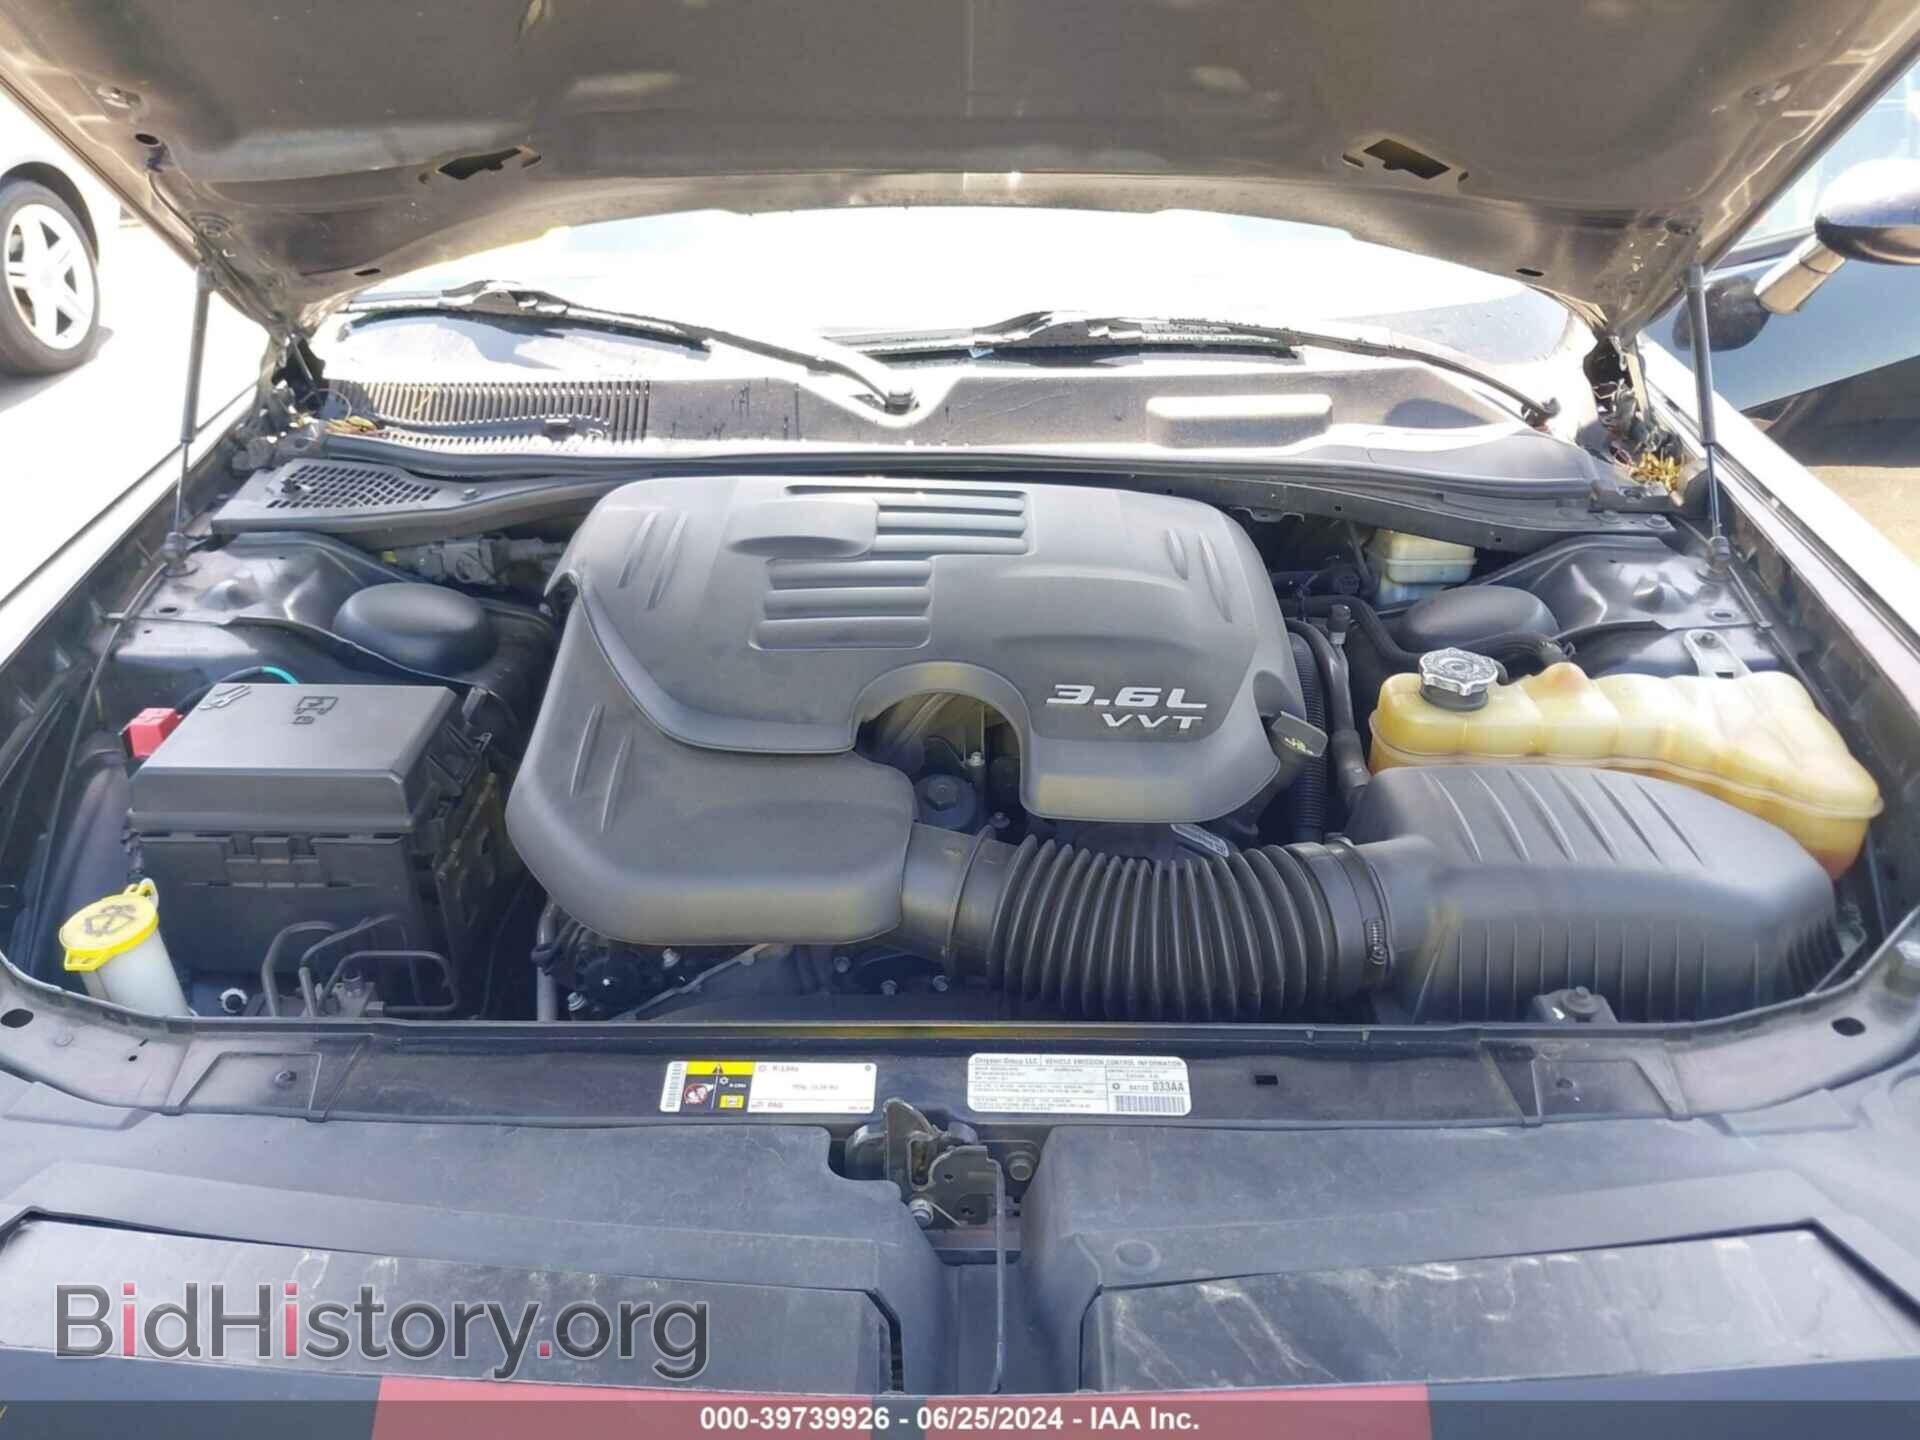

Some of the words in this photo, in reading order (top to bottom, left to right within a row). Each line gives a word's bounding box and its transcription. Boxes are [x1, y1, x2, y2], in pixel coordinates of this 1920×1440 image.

[1046, 684, 1208, 709] 3.6L
[1102, 713, 1203, 729] VVT
[1025, 1057, 1038, 1065] LLC
